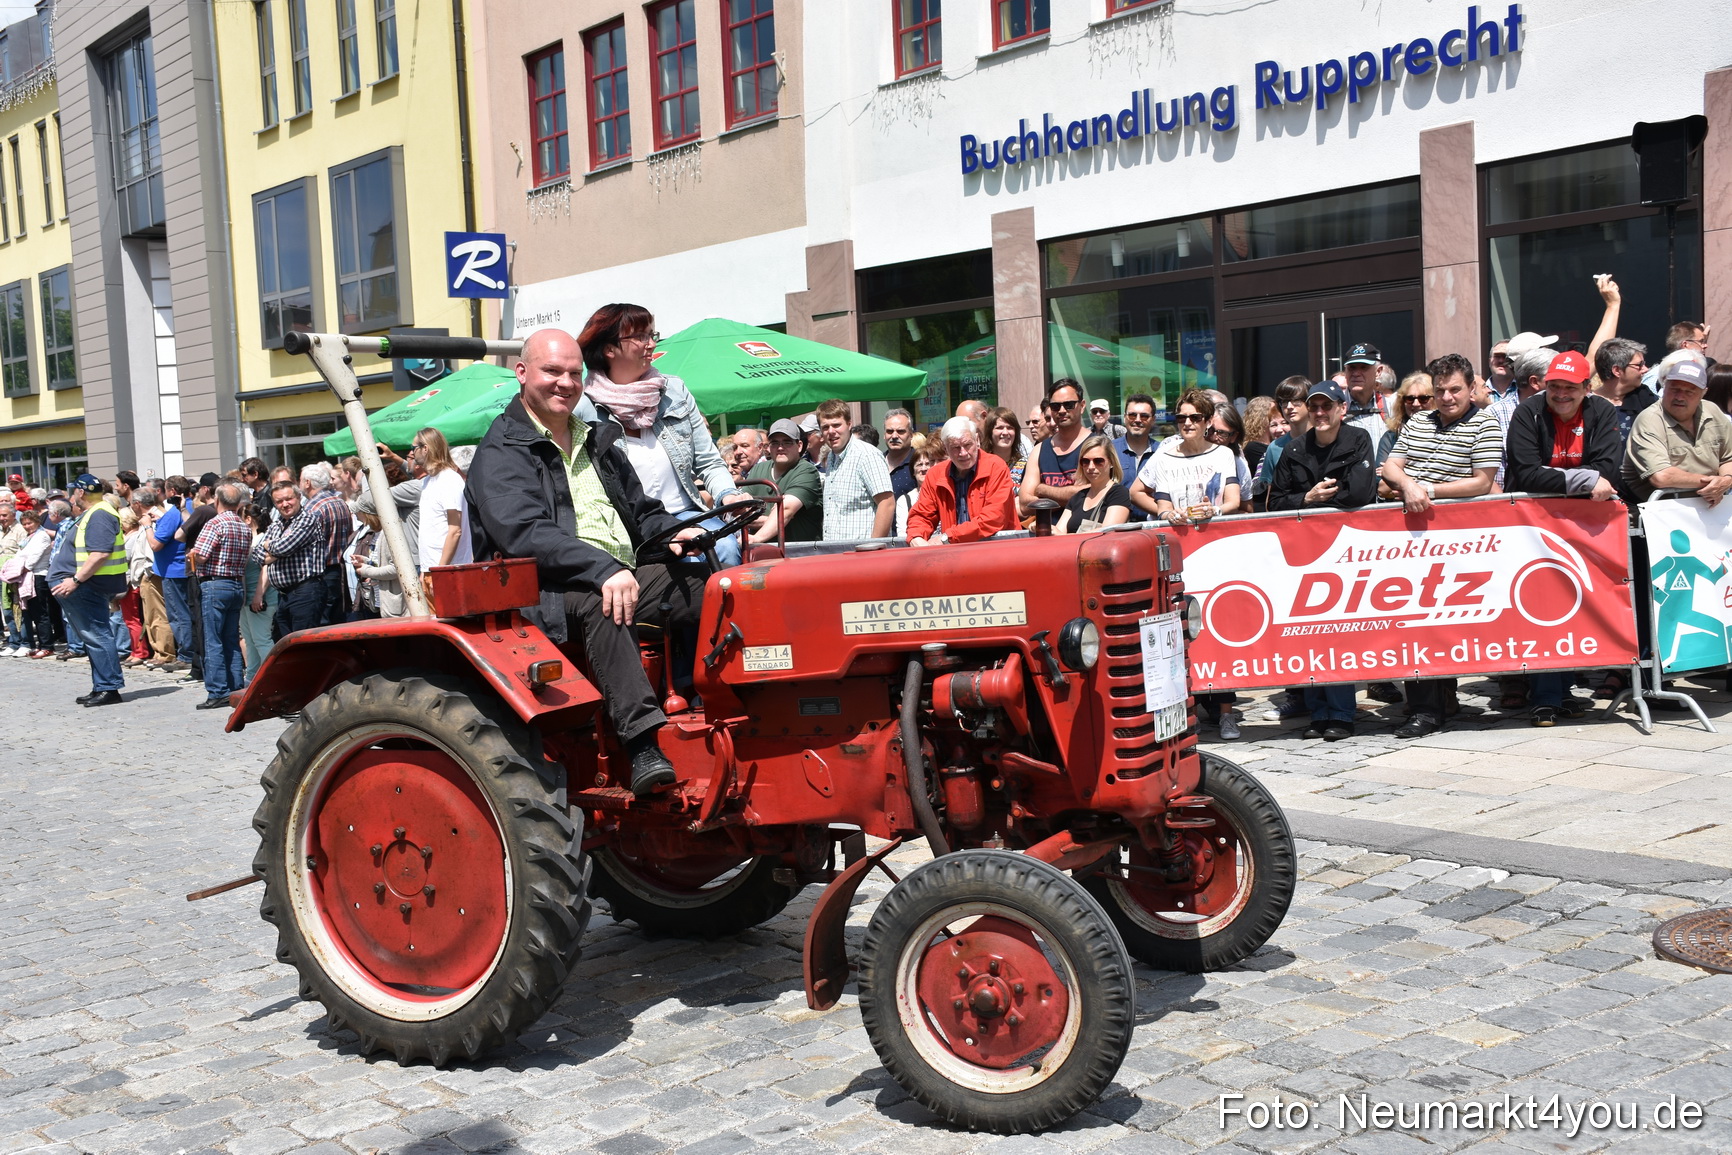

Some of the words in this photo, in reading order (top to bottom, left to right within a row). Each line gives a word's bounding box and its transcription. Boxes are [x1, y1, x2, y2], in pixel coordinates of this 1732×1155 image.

[961, 85, 1236, 175] Buchhandlung
[1255, 4, 1523, 110] Rupprecht
[515, 317, 536, 329] Unterer
[536, 313, 553, 326] Markt
[554, 310, 560, 322] 15
[734, 365, 846, 379] Lammsbräu
[1555, 363, 1575, 373] DEKRA
[963, 375, 991, 384] GARTEN
[968, 384, 988, 393] BUCH
[1335, 534, 1502, 563] Autoklassik
[1289, 563, 1494, 617] Dietz
[844, 615, 1025, 633] INTERNATIONAL
[1281, 620, 1392, 637] BREITENBRUNN
[748, 661, 790, 670] STANDARD
